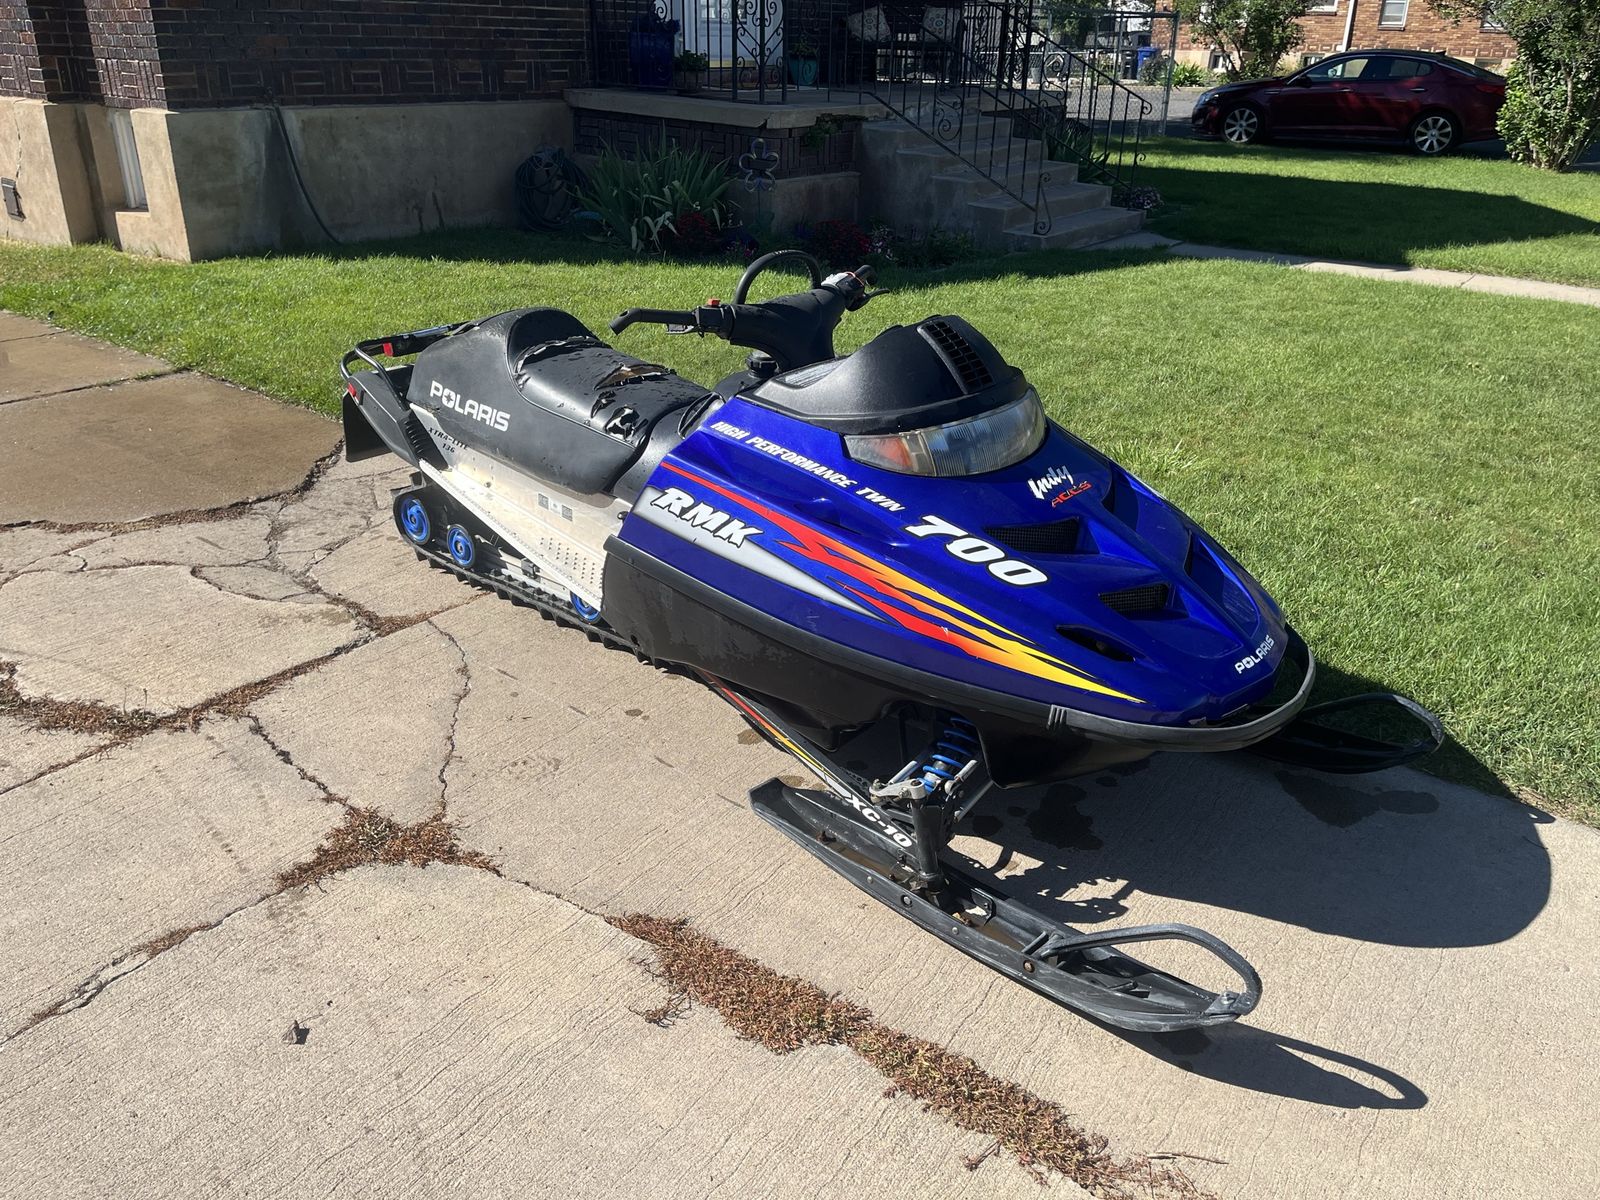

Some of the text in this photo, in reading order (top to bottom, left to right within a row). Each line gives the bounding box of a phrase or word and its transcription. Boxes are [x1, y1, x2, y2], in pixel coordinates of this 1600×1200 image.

[429, 380, 511, 432] POLARIS
[428, 427, 469, 450] XTRA-LITE
[442, 443, 455, 453] 136
[710, 421, 906, 512] HIGH PERFORMANCE TWIN
[1027, 465, 1074, 500] Indy
[650, 487, 763, 548] RMK
[906, 514, 1049, 586] 700
[1234, 634, 1275, 674] POLARIS
[844, 794, 913, 848] XC-10
